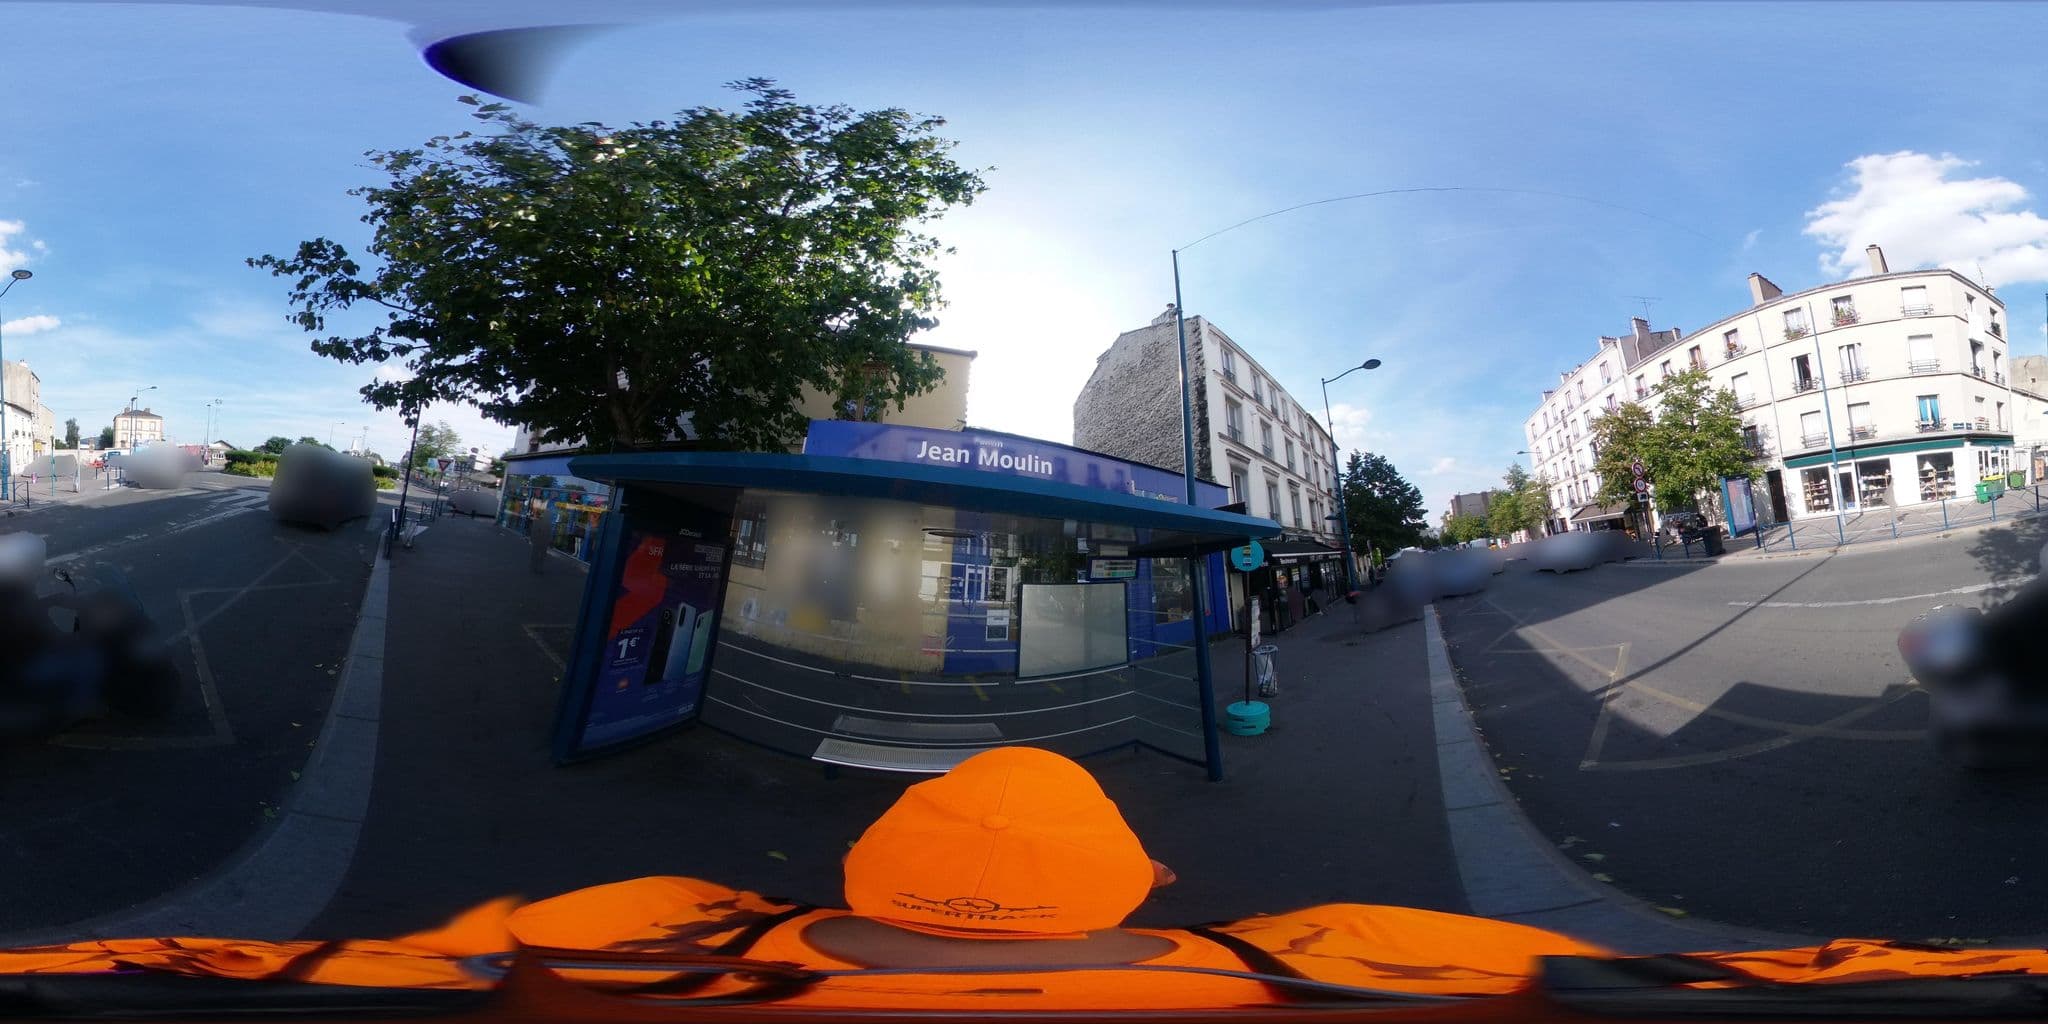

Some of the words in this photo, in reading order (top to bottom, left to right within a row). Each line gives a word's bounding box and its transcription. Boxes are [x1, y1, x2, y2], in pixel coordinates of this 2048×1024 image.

[917, 441, 970, 464] Jean
[978, 447, 1053, 475] Moulin
[648, 546, 664, 557] SFR
[891, 899, 1057, 921] SUPERTRACK
